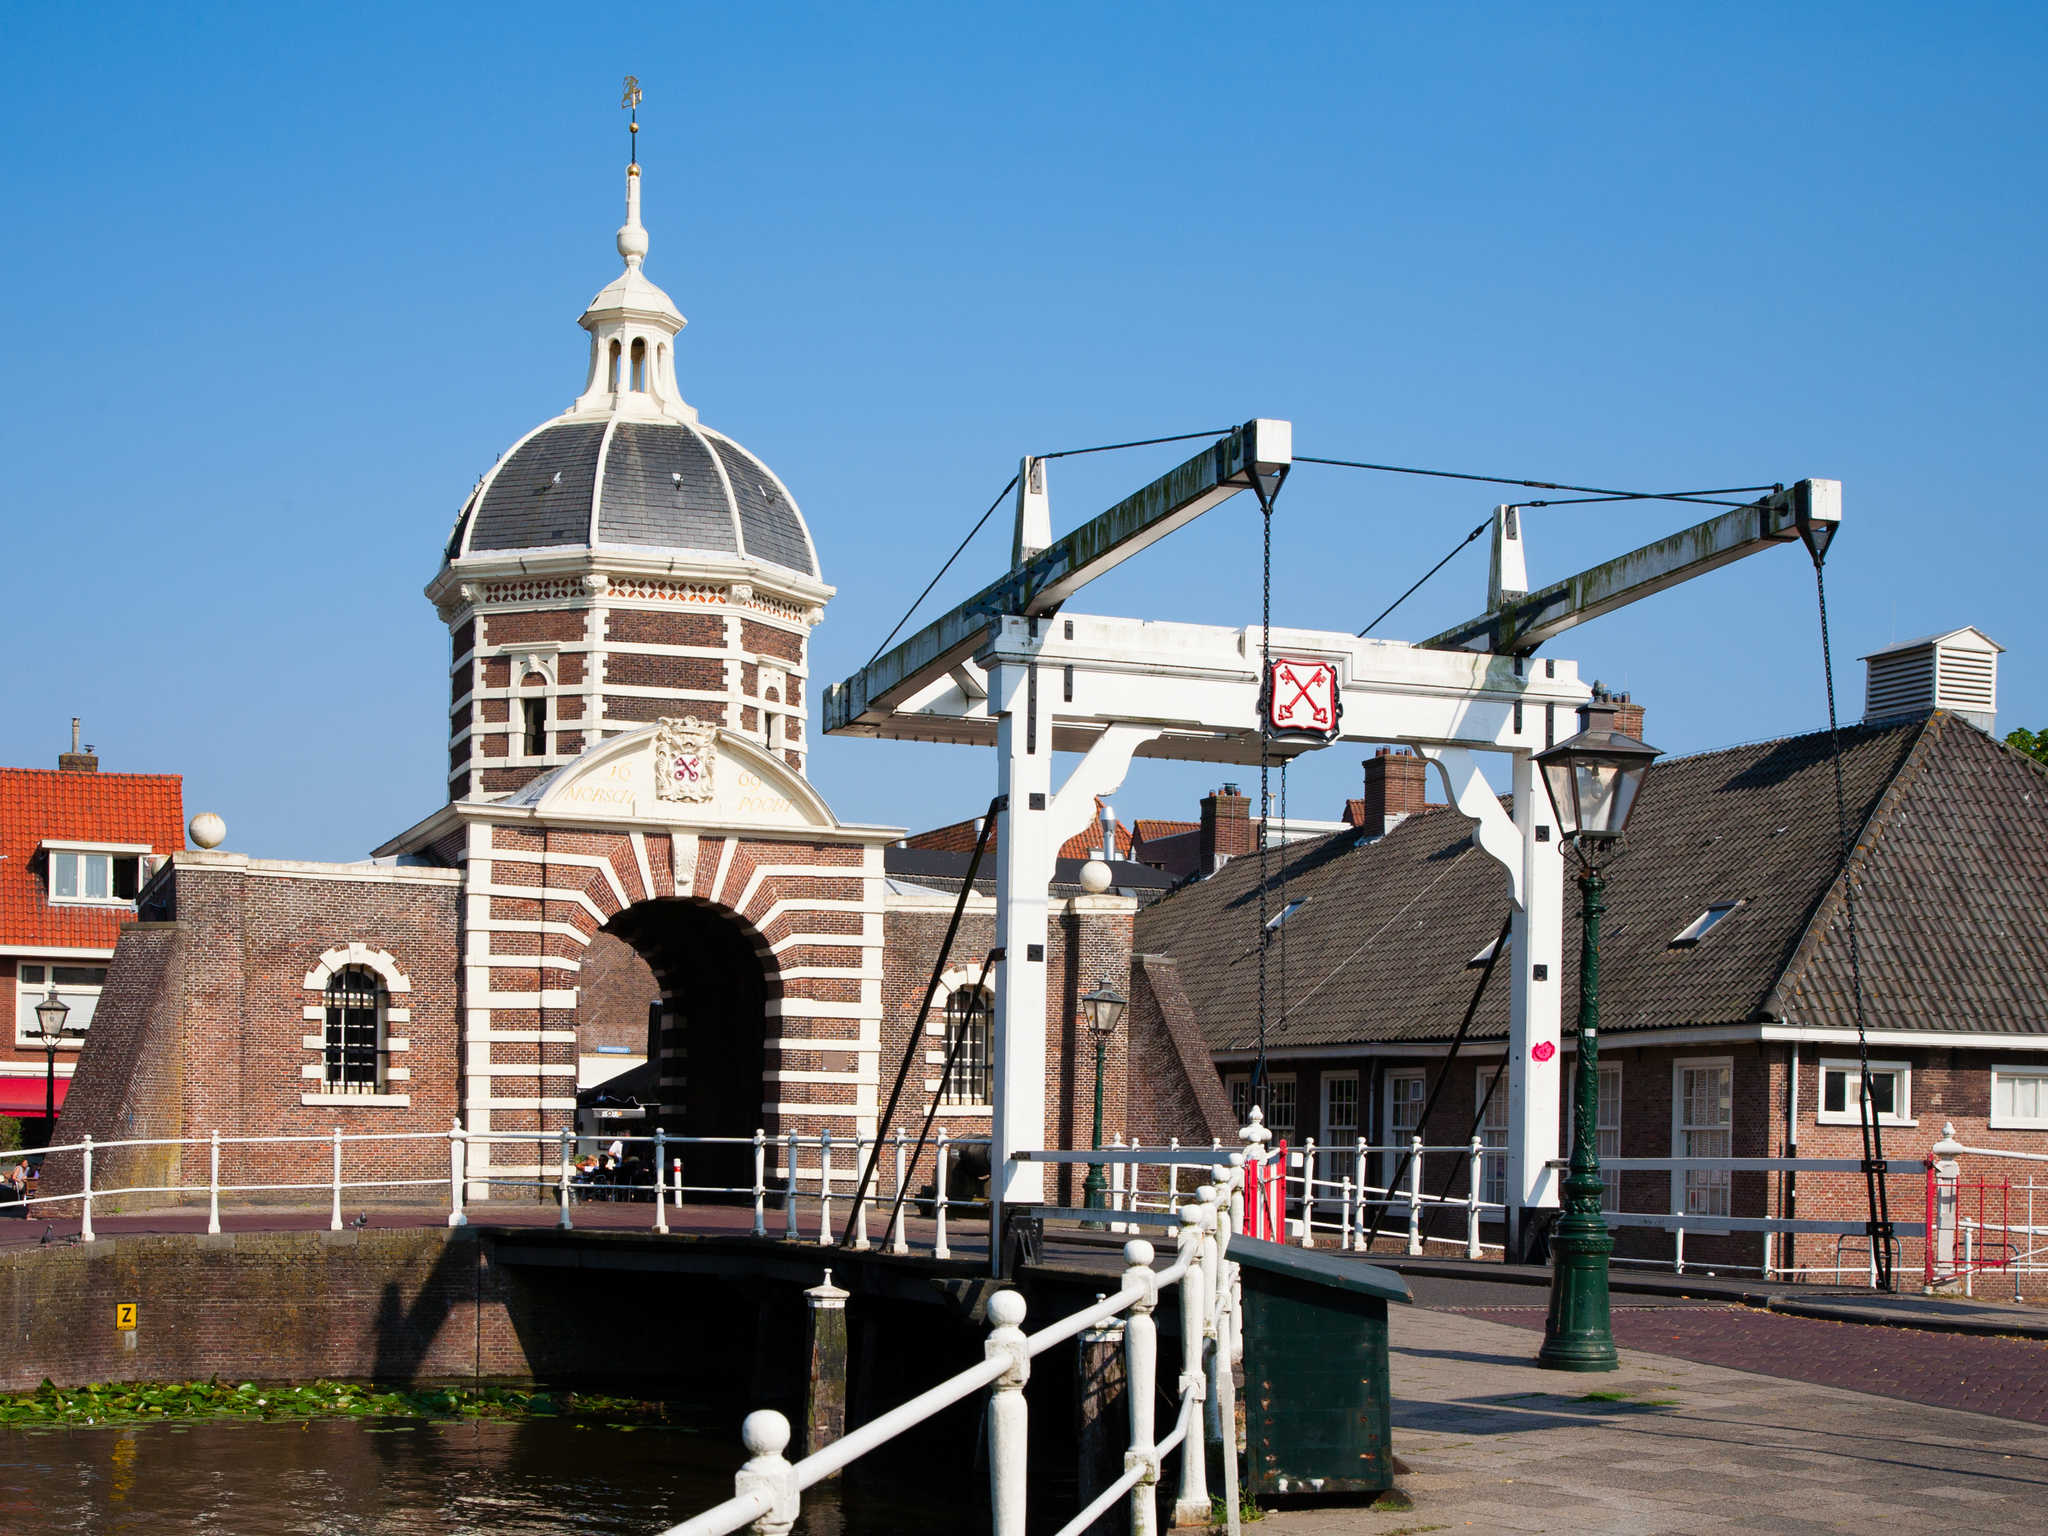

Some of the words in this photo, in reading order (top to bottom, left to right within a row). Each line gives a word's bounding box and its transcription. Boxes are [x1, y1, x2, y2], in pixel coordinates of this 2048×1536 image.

[609, 761, 632, 782] 16
[737, 770, 762, 790] 69
[122, 1307, 131, 1322] Z
